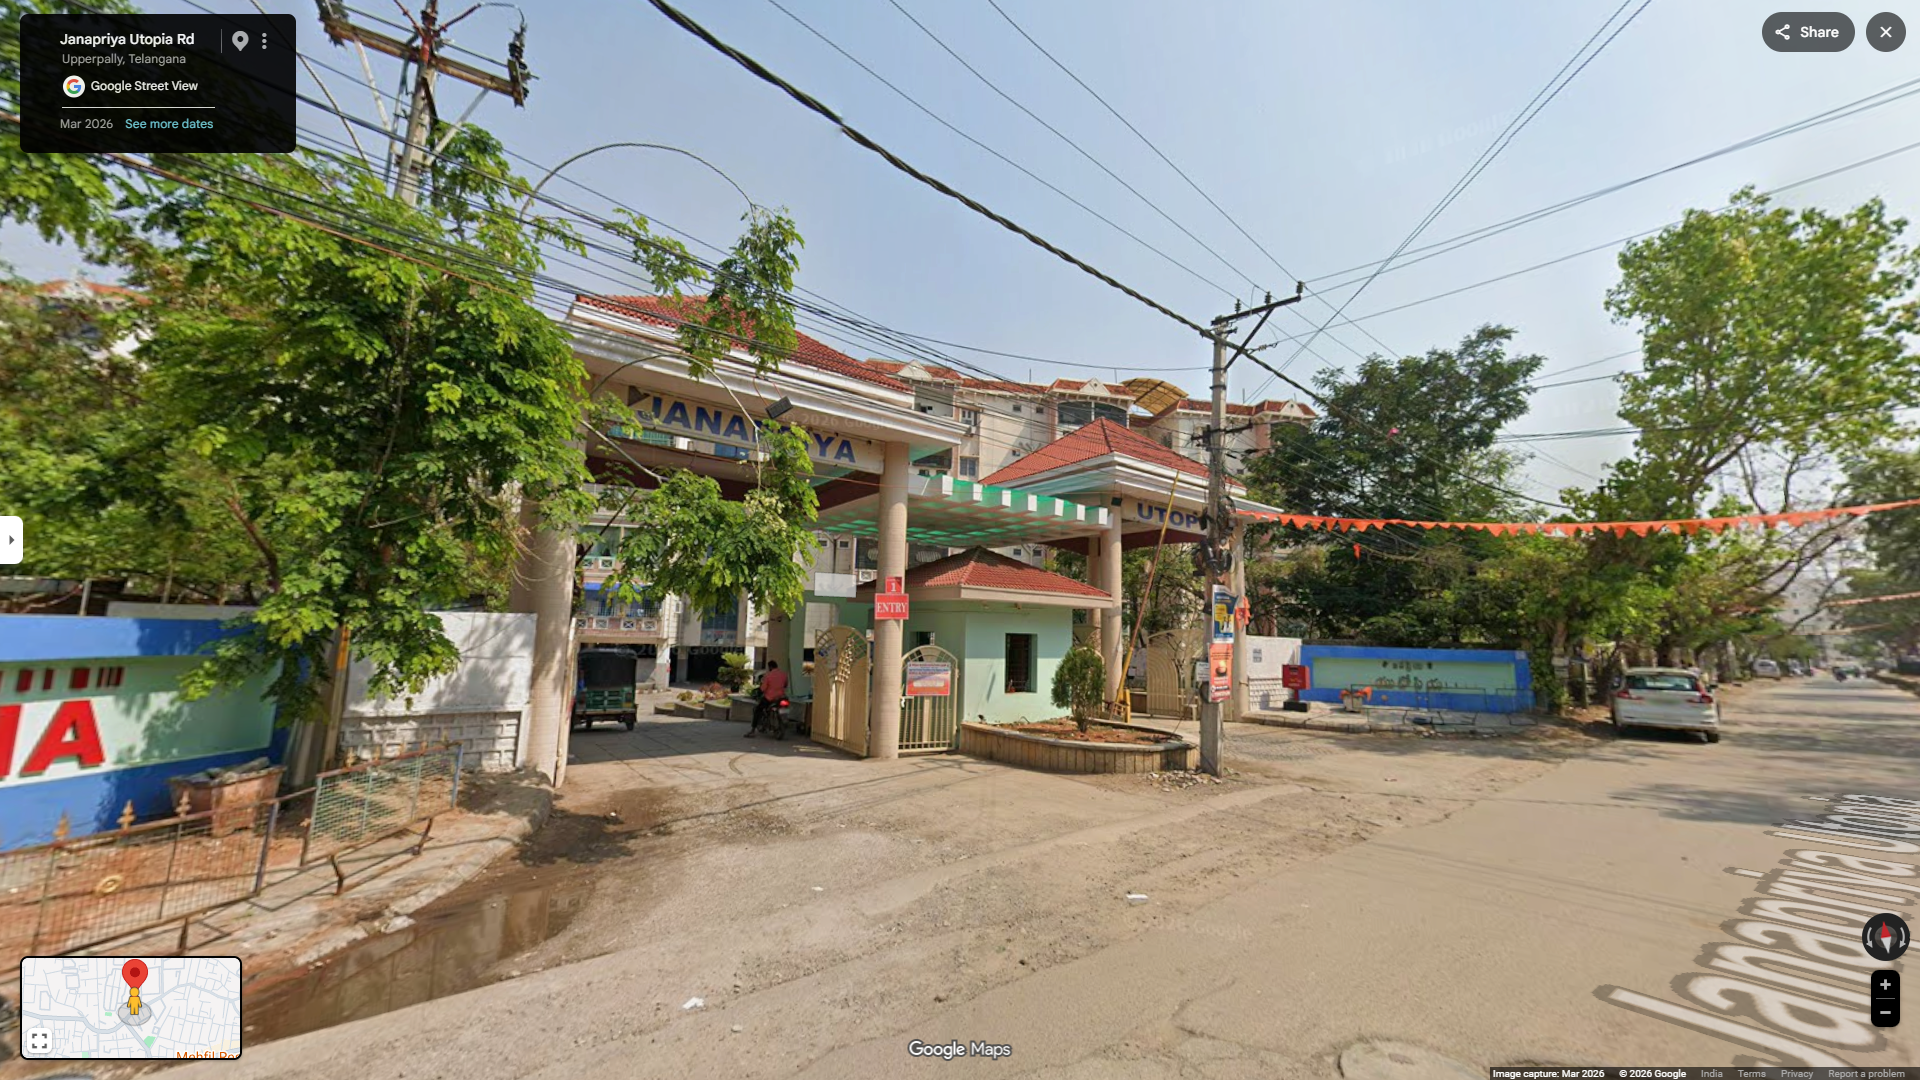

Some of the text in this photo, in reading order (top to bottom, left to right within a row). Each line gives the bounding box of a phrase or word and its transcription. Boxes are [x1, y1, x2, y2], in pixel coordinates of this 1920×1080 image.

[637, 396, 856, 463] JANAYA
[1138, 502, 1201, 529] UTOP
[890, 582, 897, 592] 1
[876, 602, 908, 613] ENTRY
